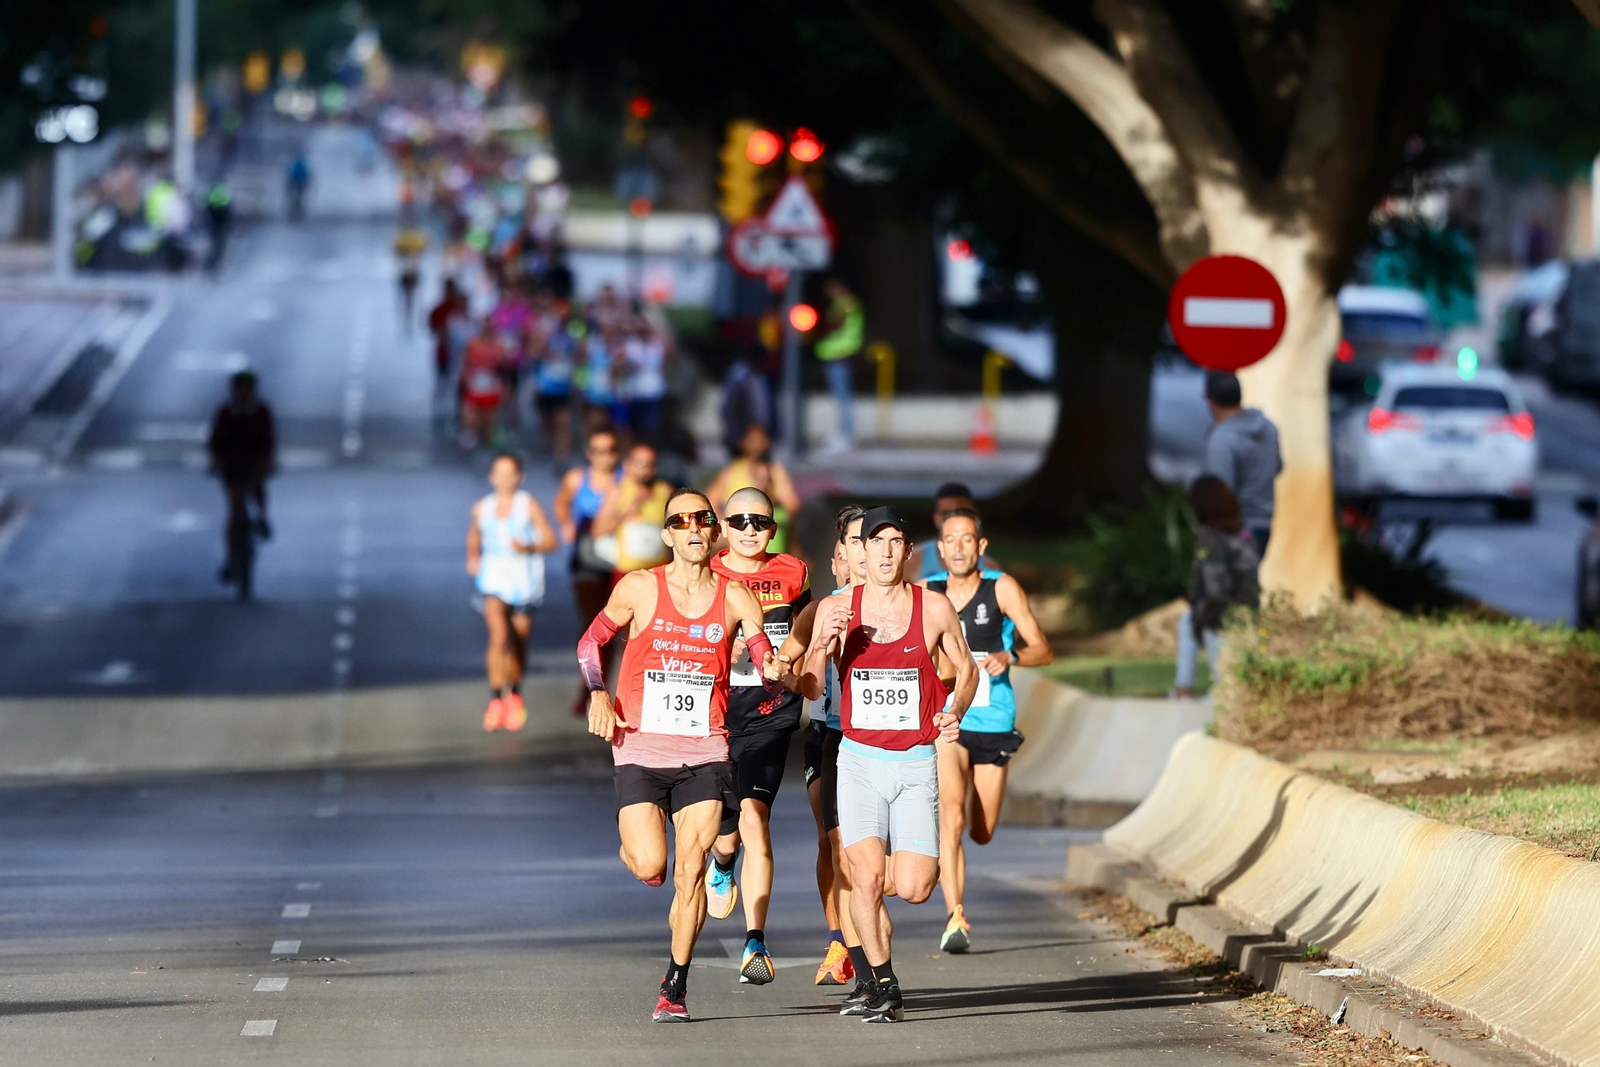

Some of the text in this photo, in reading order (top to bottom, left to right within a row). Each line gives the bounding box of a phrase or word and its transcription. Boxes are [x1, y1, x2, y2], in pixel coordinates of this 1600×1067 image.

[746, 579, 782, 594] laga
[647, 671, 666, 684] 43
[853, 670, 870, 680] 43
[663, 694, 695, 712] 139
[862, 688, 909, 706] 9589
